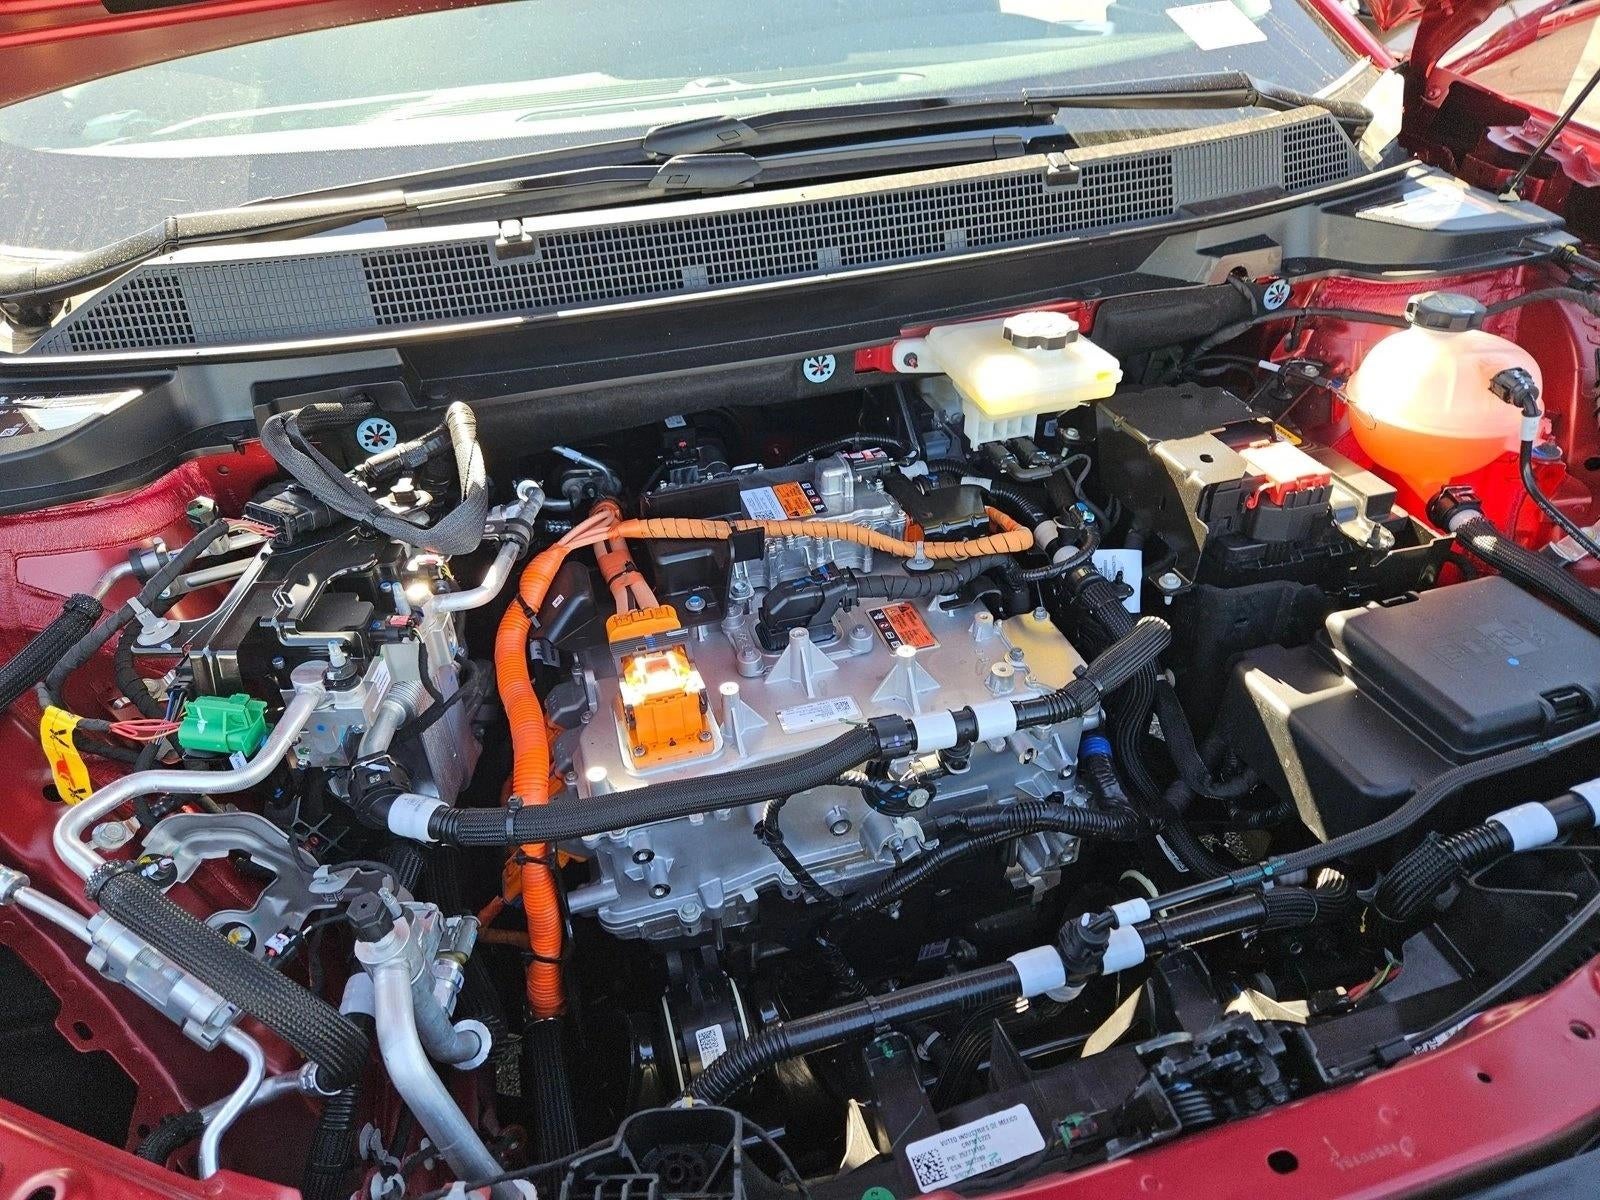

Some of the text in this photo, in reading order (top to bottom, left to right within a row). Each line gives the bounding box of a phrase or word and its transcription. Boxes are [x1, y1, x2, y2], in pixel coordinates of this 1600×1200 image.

[958, 1125, 989, 1140] INDUSTRIES
[989, 1121, 998, 1129] DE
[998, 1115, 1018, 1126] MEXICO
